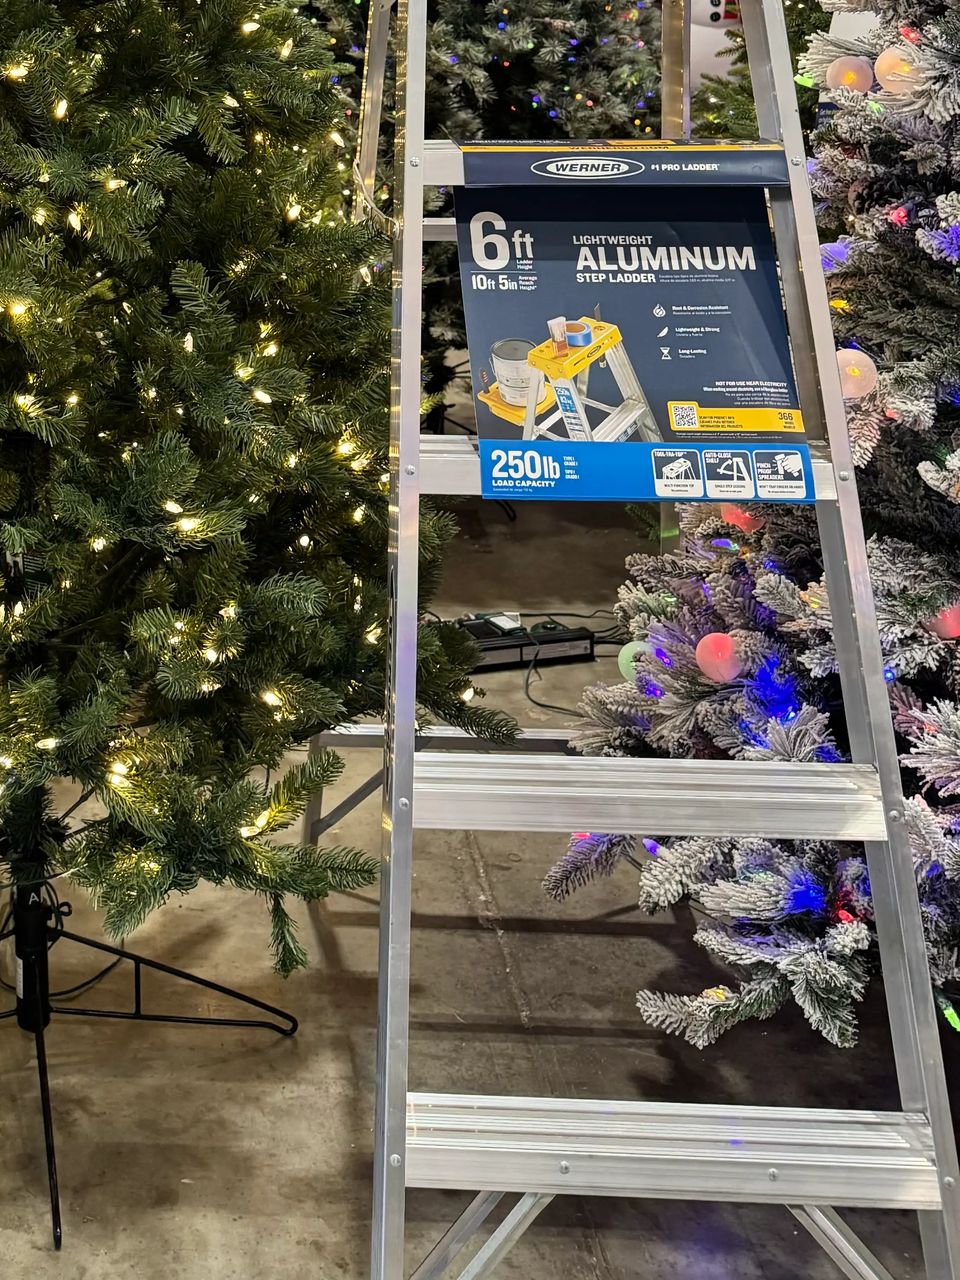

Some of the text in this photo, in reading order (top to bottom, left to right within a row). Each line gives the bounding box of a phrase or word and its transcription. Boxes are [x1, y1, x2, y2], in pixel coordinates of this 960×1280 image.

[555, 163, 622, 172] WERNER
[682, 163, 719, 171] LADDER
[572, 235, 653, 245] LIGHTWEIGHT
[576, 246, 757, 271] ALUMINUM
[576, 273, 606, 283] STEP
[609, 273, 656, 283] LADDER
[777, 412, 793, 421] 366
